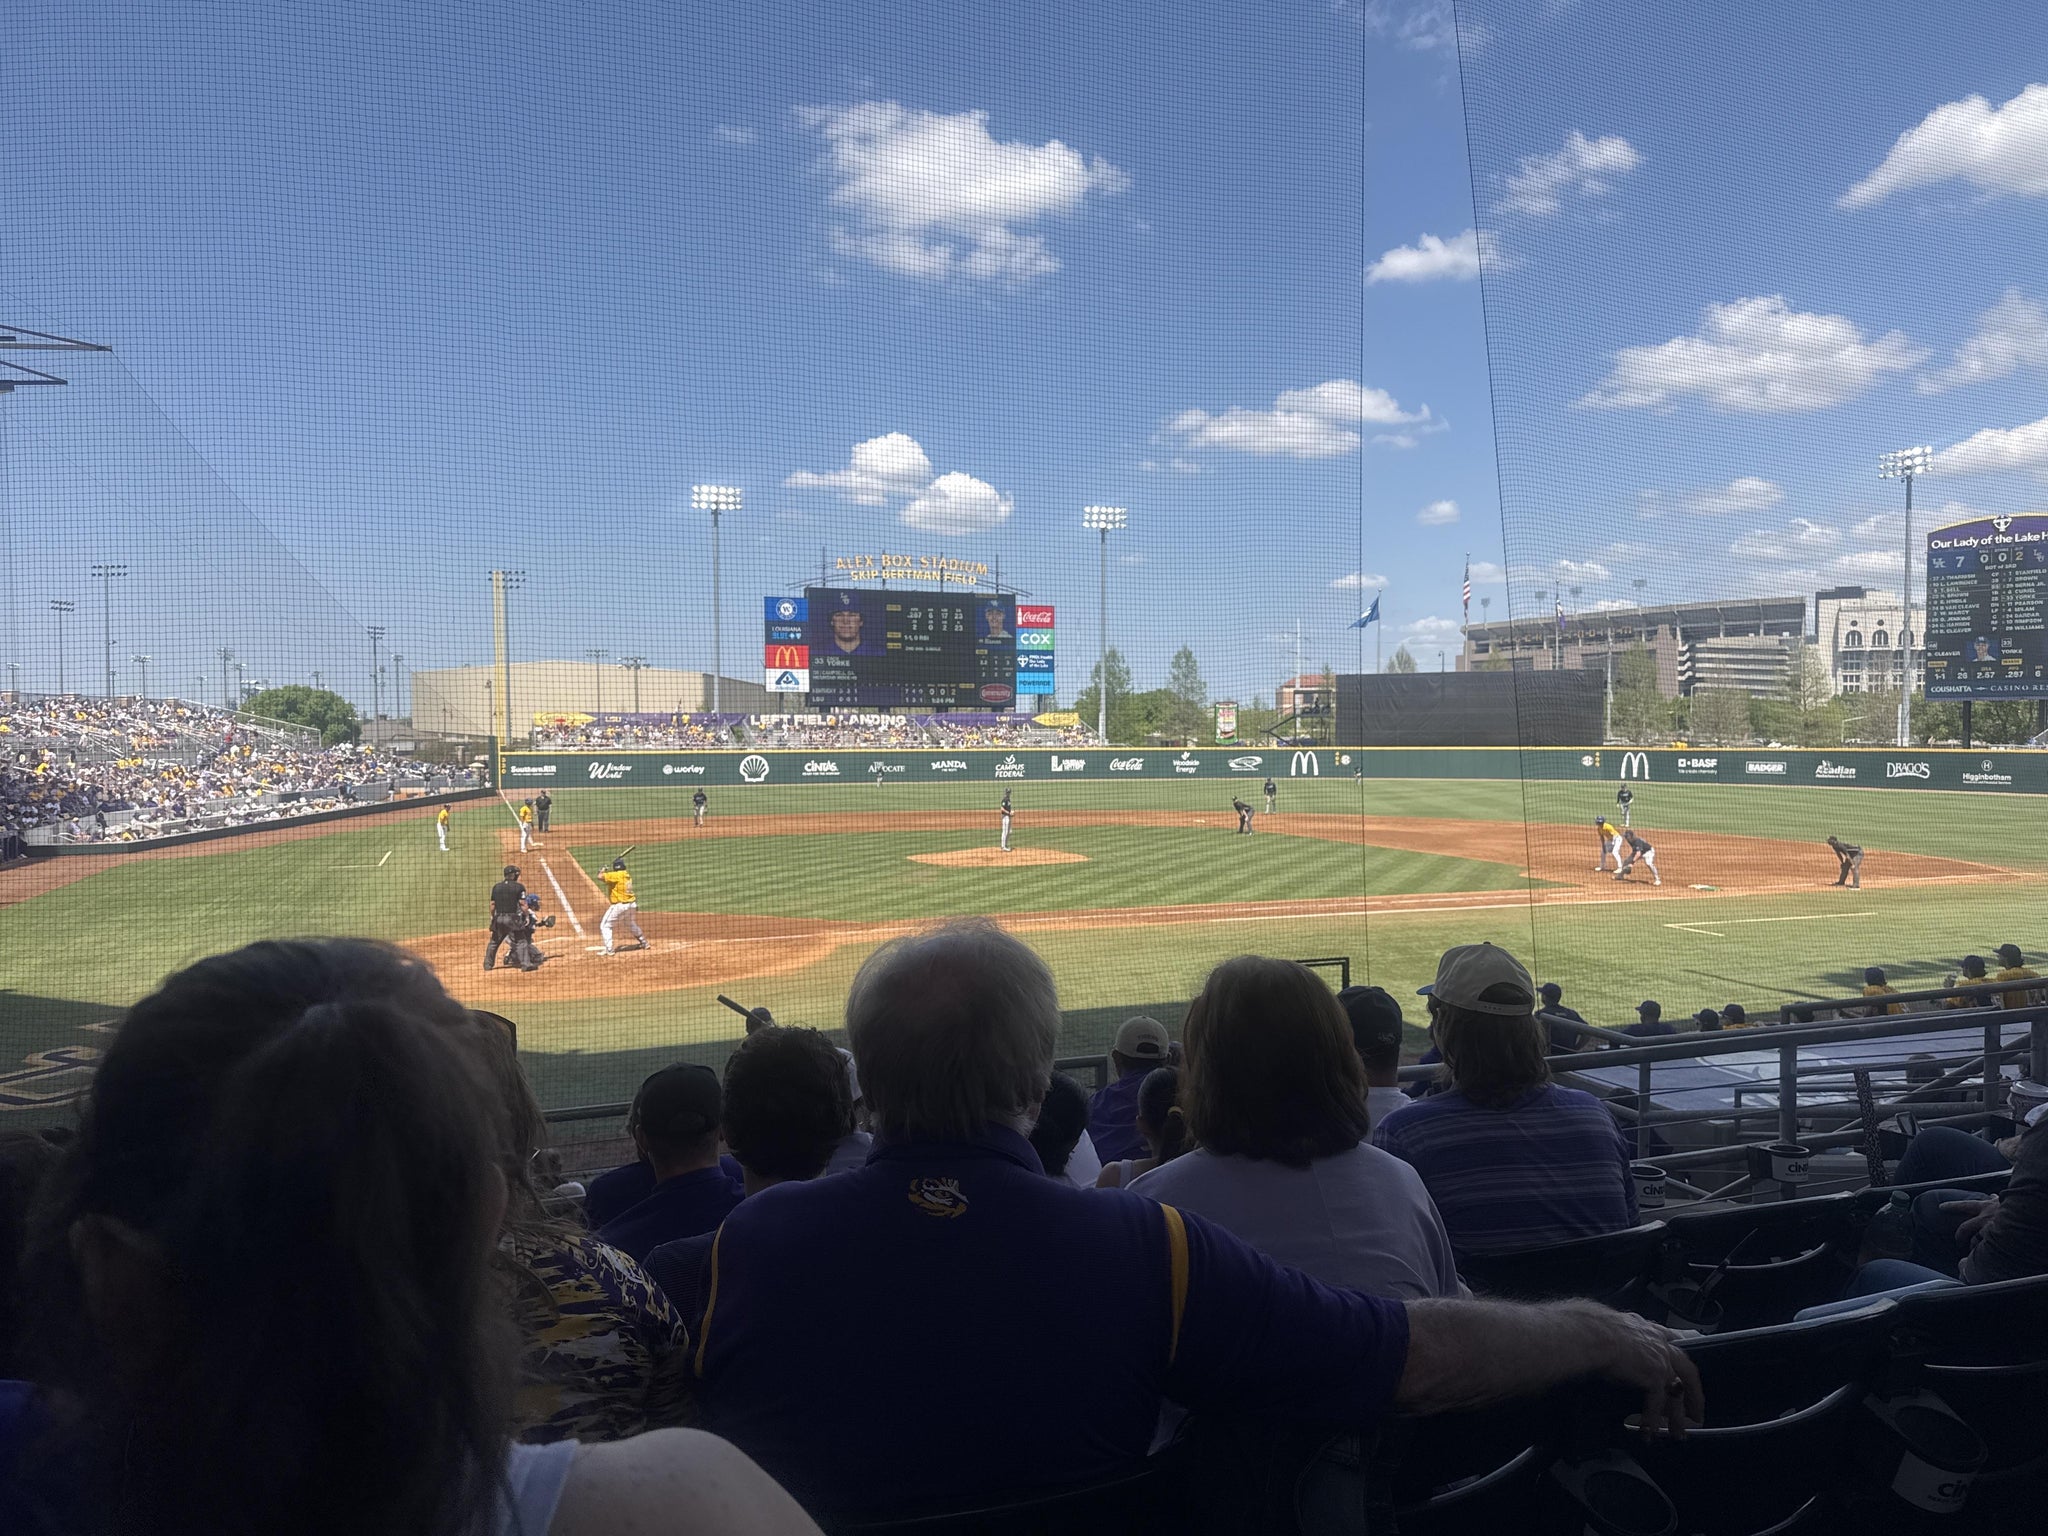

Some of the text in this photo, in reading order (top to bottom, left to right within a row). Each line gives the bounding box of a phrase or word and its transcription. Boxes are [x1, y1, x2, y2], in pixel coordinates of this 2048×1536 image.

[1931, 540, 1952, 549] Our
[1953, 537, 1979, 548] Lady
[1981, 535, 1993, 545] of
[1995, 534, 2013, 544] the
[2014, 532, 2040, 542] Lake
[836, 554, 988, 576] ALEX BOX STADIUM
[1955, 556, 1965, 568] 7
[1980, 553, 1989, 564] 0
[1998, 552, 2007, 562] 0
[2015, 551, 2023, 561] 2
[851, 570, 977, 585] SKIP BERTMAN FIELD
[1020, 633, 1050, 645] COX
[750, 714, 791, 726] LEFT
[793, 714, 837, 726] FIELD
[931, 760, 967, 770] MANDA
[1109, 758, 1145, 771] Coca-Cola
[1692, 759, 1718, 768] BASF
[1748, 763, 1784, 772] BADGER
[1815, 764, 1856, 774] Acadian
[674, 765, 705, 775] worley
[1175, 766, 1196, 774] Energy
[1886, 762, 1931, 779] DRAGO'S
[1963, 773, 2012, 781] Higginbotham
